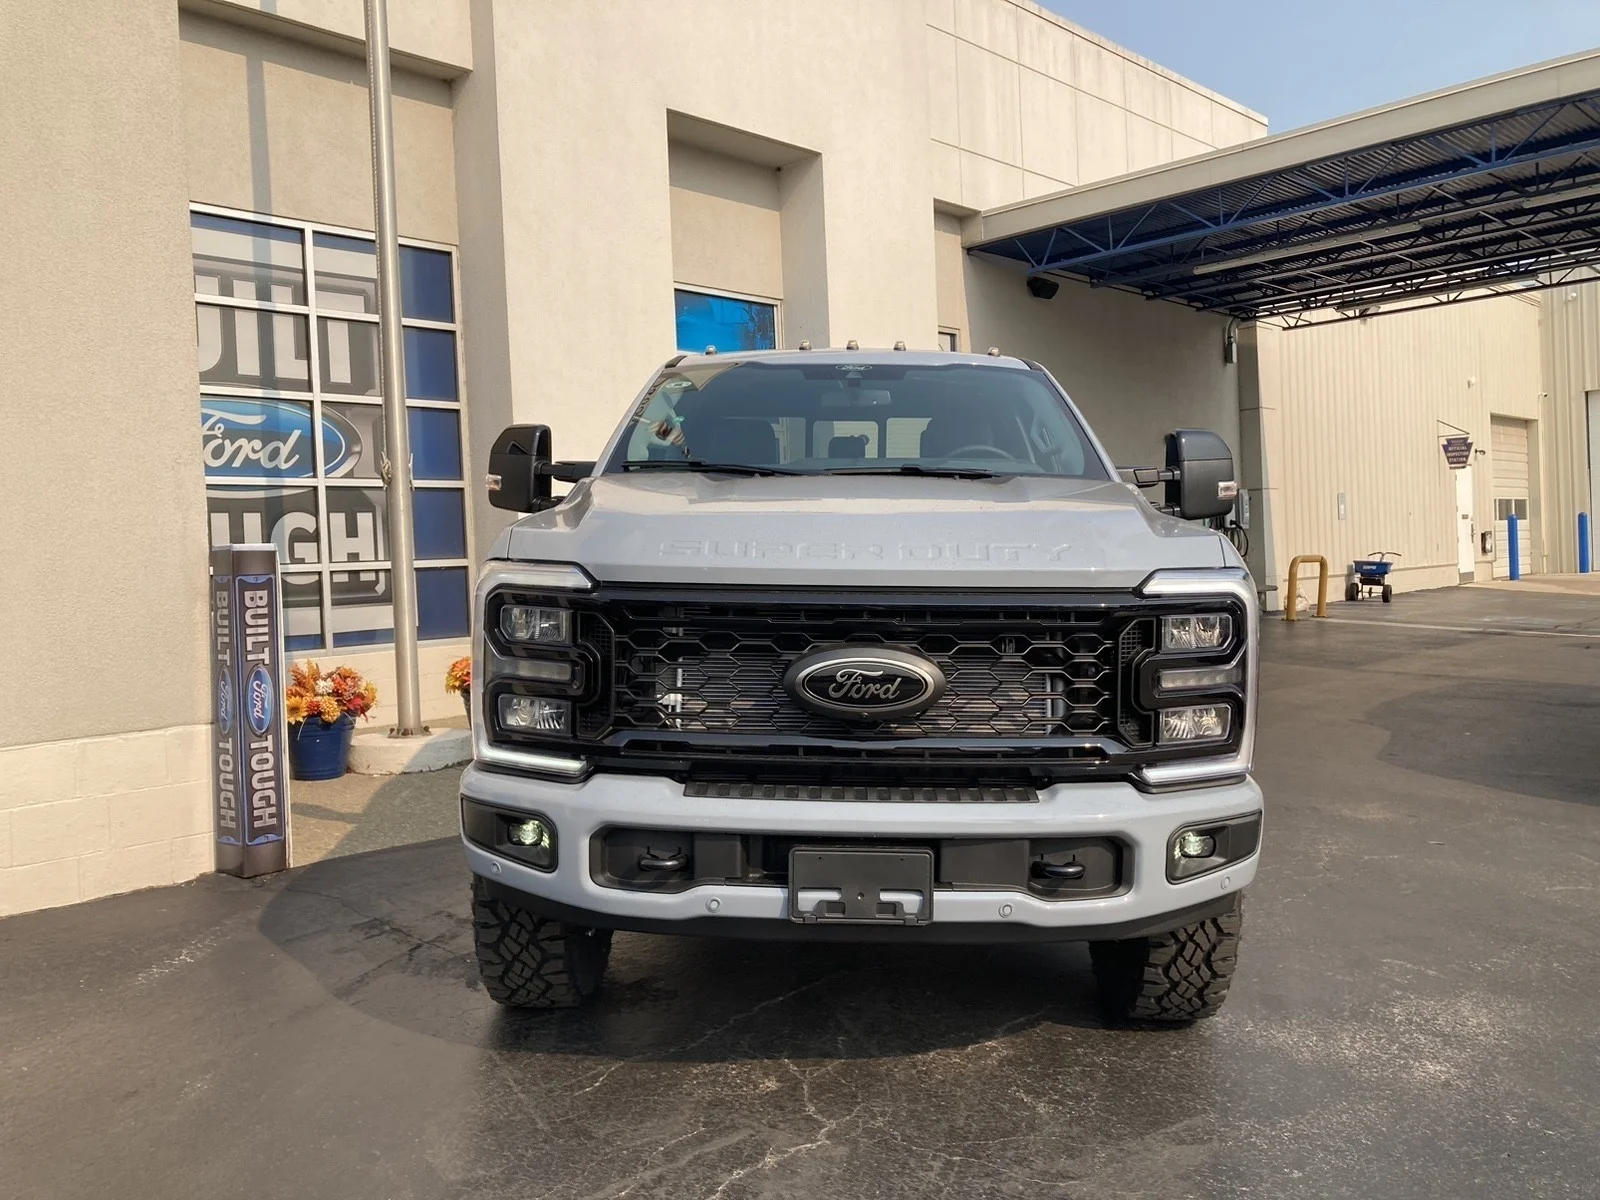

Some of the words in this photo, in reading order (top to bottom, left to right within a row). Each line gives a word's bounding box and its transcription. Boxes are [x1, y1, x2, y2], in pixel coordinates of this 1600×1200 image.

[658, 540, 884, 561] SUPER
[898, 543, 1072, 562] DUTY
[216, 591, 230, 666] BUILT
[244, 590, 270, 665] BUILT
[220, 681, 231, 720] Ford
[252, 680, 269, 719] Ford
[828, 668, 902, 699] Ford
[218, 737, 236, 829] TOUGH
[250, 734, 277, 828] TOUGH
